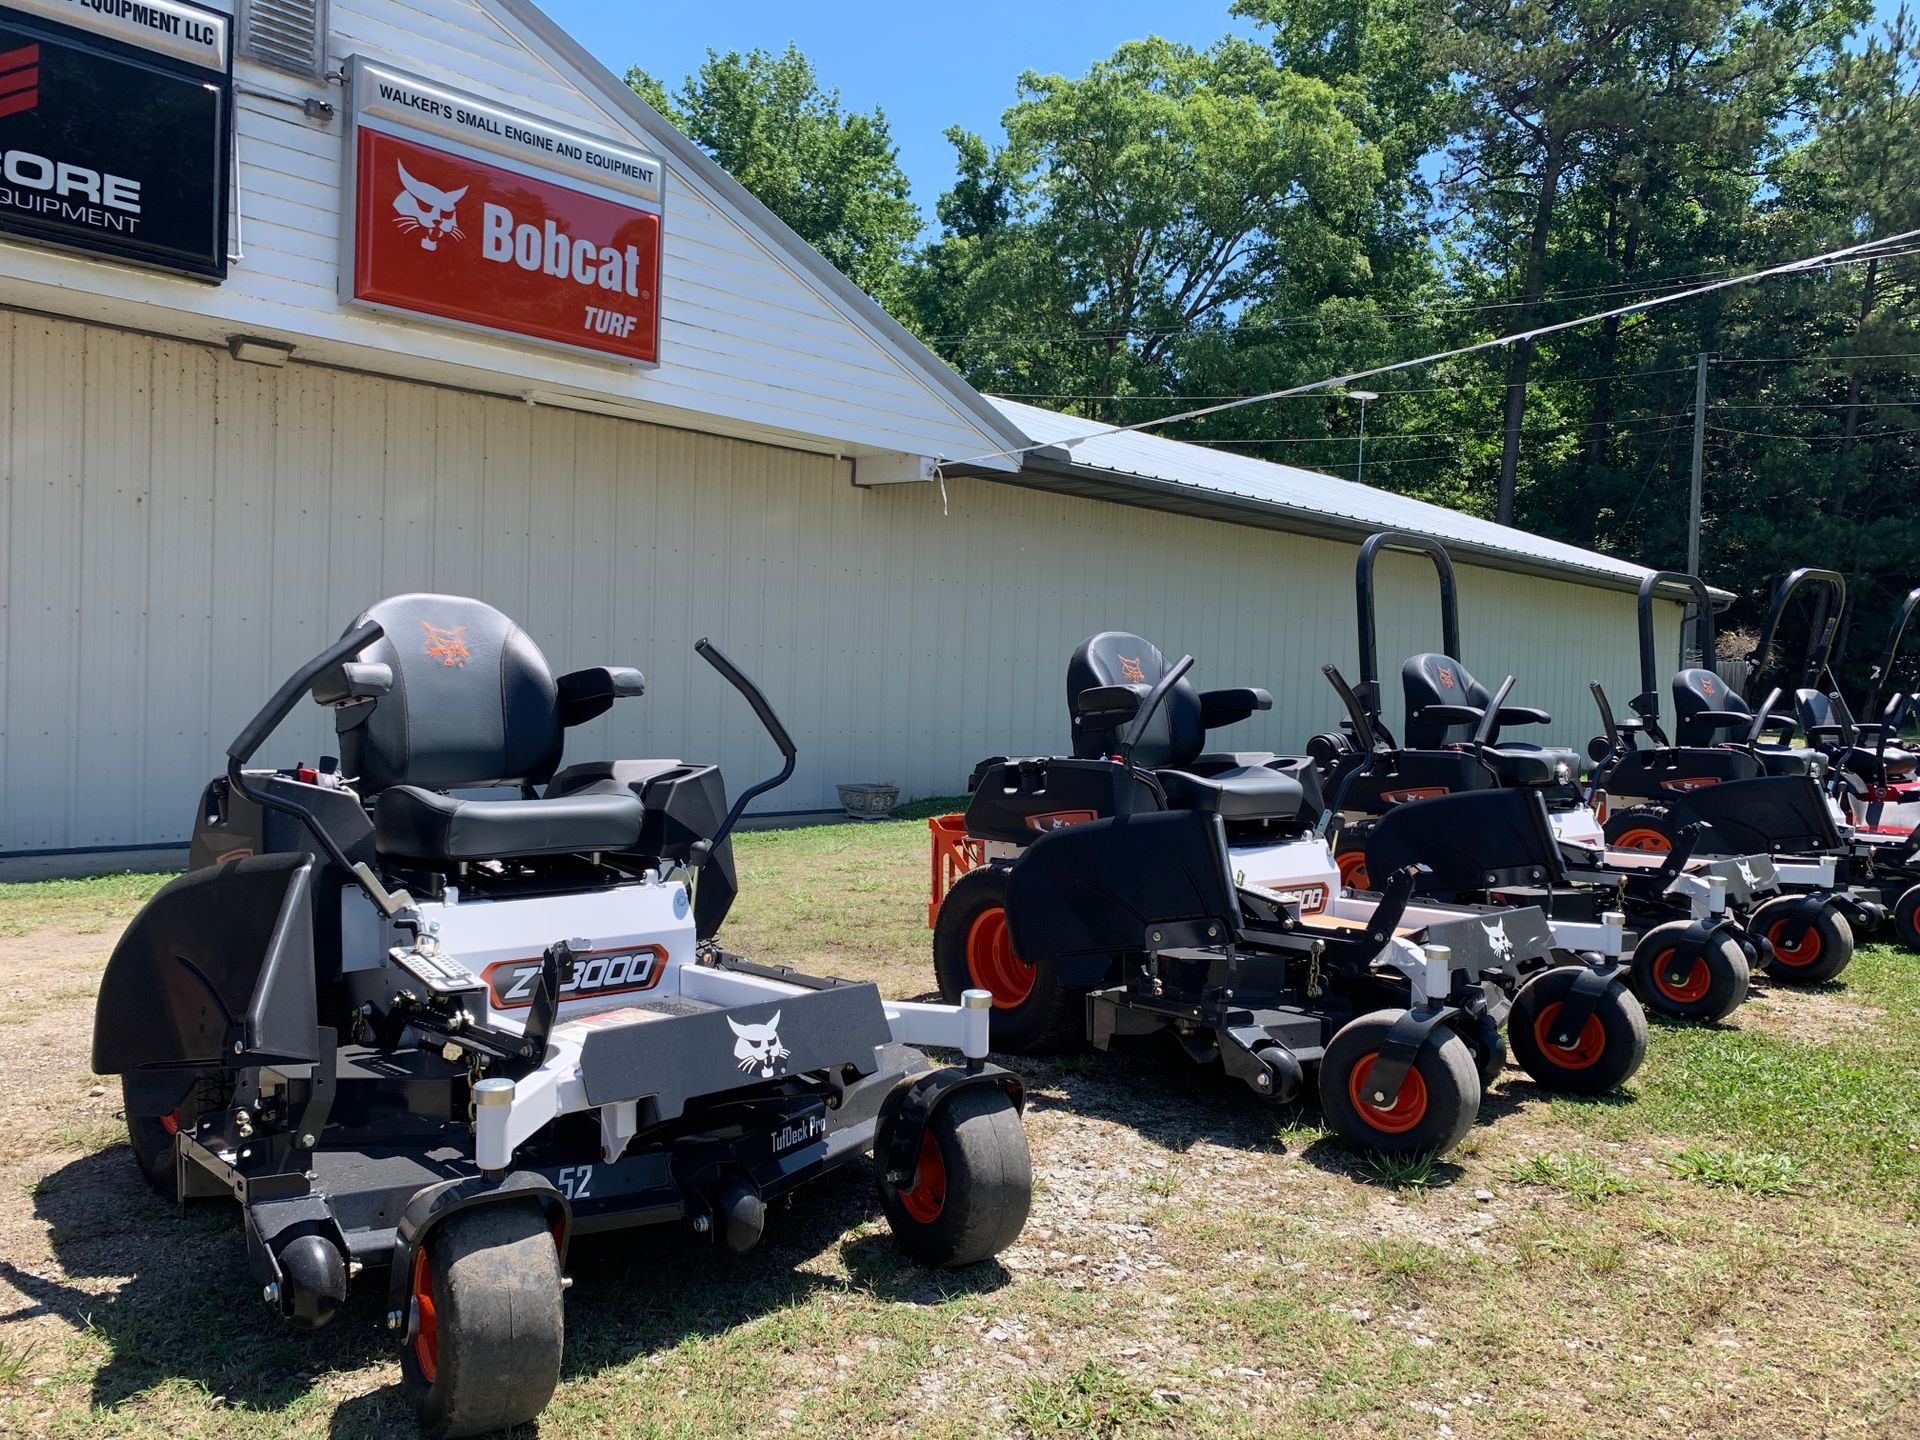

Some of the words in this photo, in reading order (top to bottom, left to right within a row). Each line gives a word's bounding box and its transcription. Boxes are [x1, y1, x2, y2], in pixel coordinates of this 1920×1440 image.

[185, 20, 214, 46] LLC
[379, 83, 452, 119] WALKER'S
[457, 110, 501, 135] SMALL
[505, 125, 553, 152] ENGINE
[556, 142, 582, 160] AND
[585, 152, 654, 183] EQUIPMENT
[482, 202, 639, 298] Bobcat
[584, 306, 637, 338] TURF
[504, 953, 655, 999] Z3000
[770, 1120, 808, 1153] TufDeck
[809, 1115, 826, 1137] Pro
[558, 1164, 593, 1200] 52
